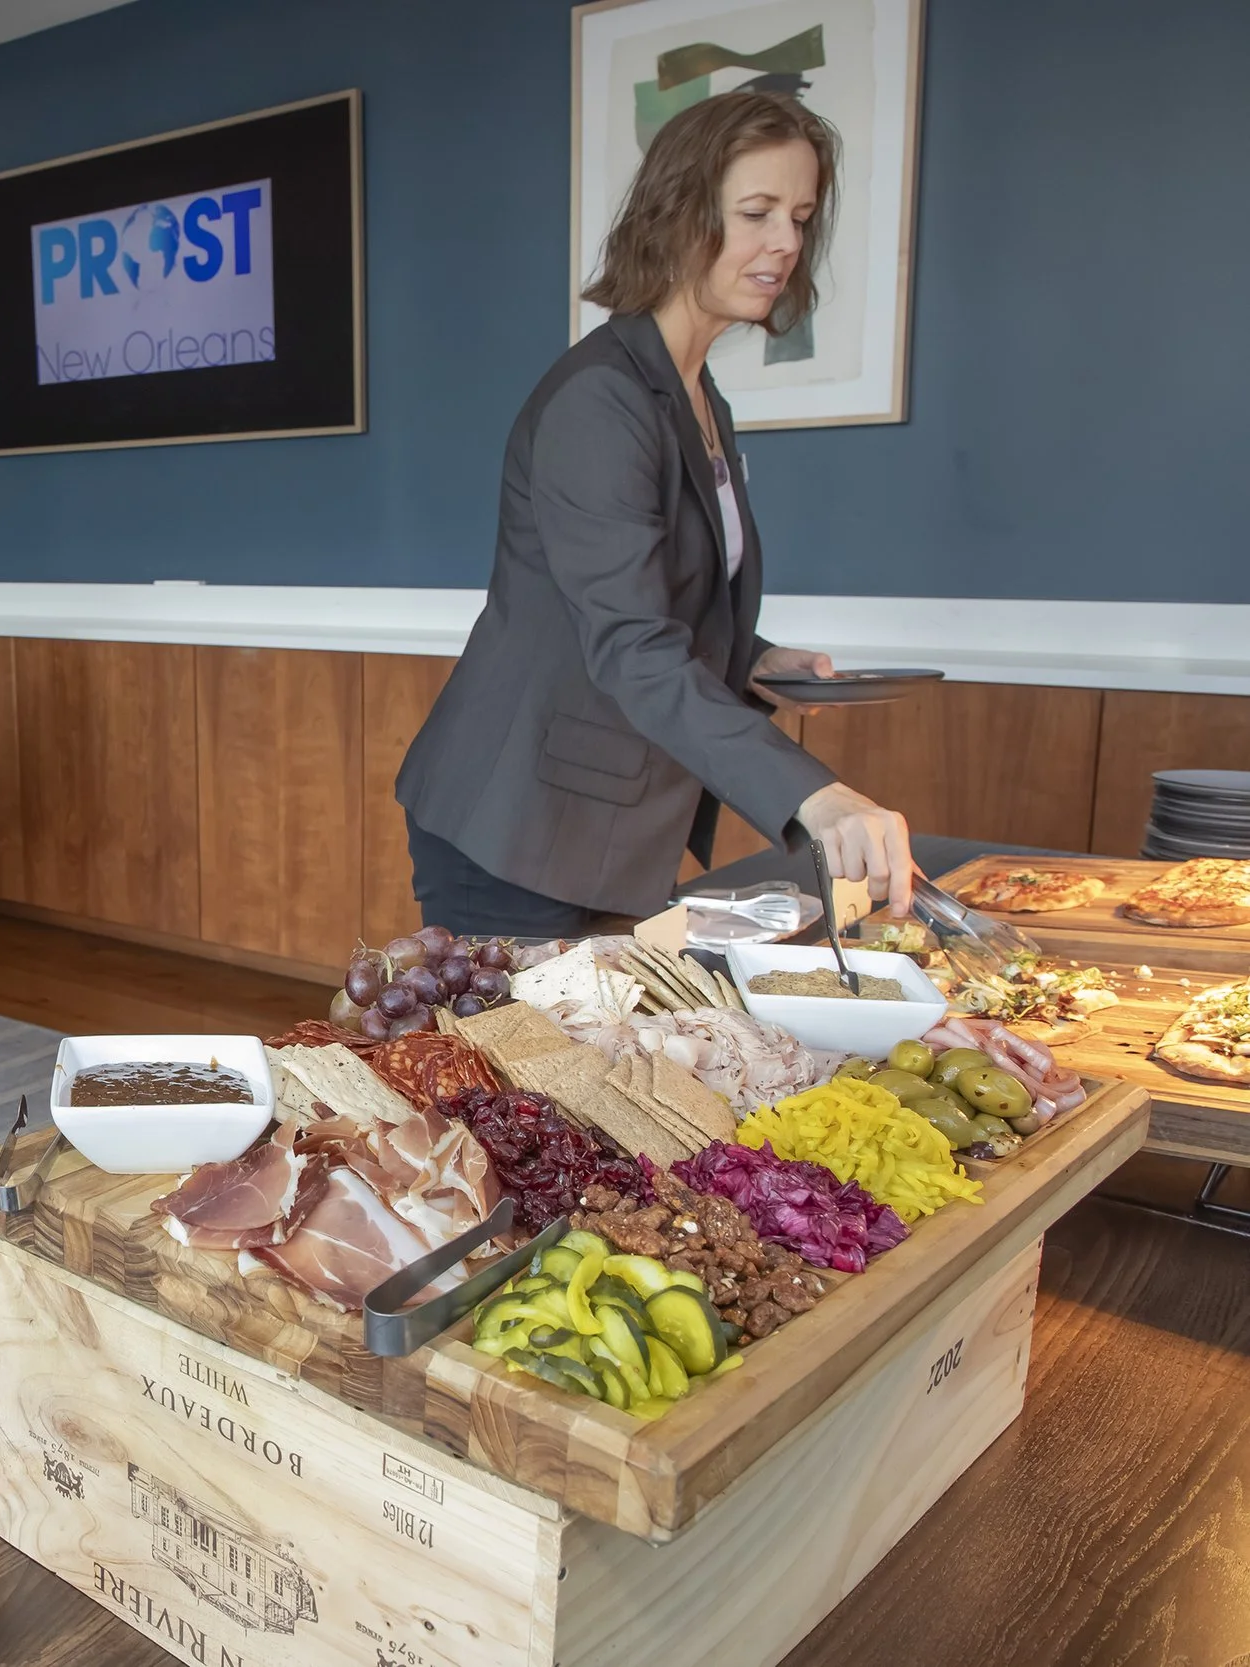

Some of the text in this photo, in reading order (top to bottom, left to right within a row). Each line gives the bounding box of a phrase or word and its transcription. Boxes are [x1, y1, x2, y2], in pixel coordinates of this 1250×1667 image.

[39, 188, 261, 305] PROST
[36, 326, 275, 382] New Orleans
[178, 1353, 250, 1408] WHITE
[51, 1443, 75, 1461] 1875
[140, 1374, 304, 1479] BORDEAUX
[397, 1465, 411, 1478] HT
[418, 1519, 435, 1549] 12
[93, 1561, 208, 1667] RIVIÈRE
[388, 1640, 425, 1665] 1875
